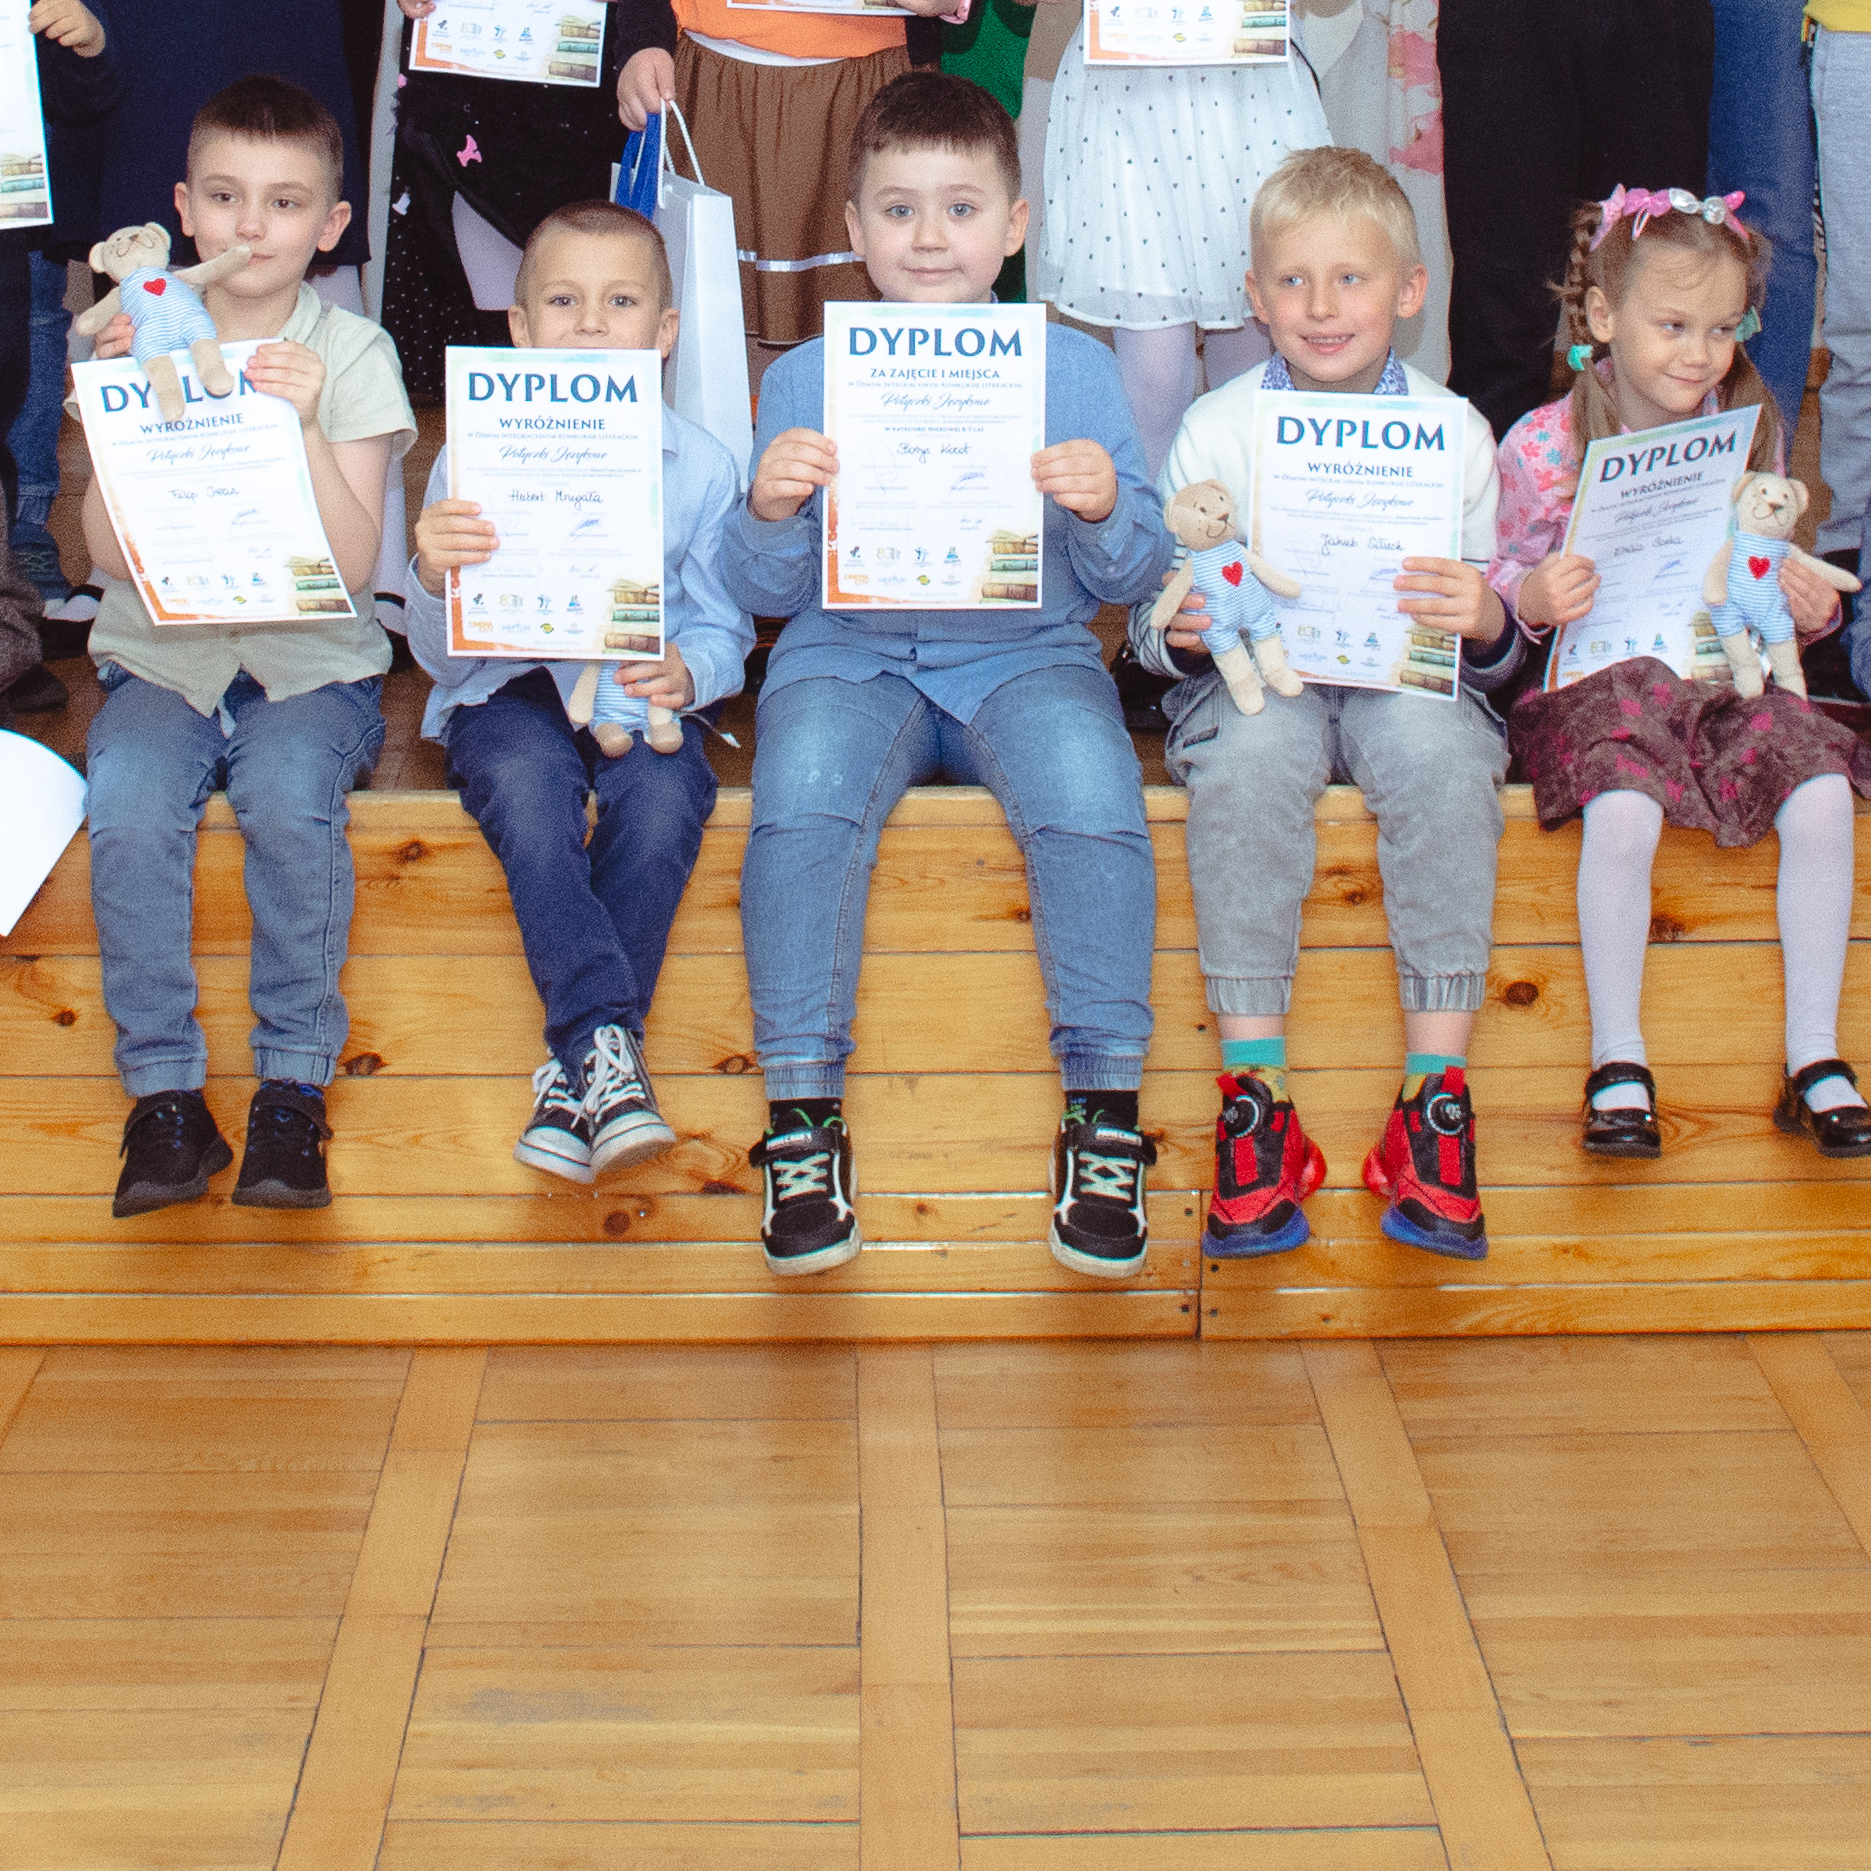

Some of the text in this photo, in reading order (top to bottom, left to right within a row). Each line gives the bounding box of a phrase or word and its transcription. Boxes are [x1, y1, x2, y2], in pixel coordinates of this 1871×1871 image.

[849, 327, 1022, 357] DYPLOM
[469, 372, 638, 403] DYPLOM
[870, 369, 1000, 382] ZA ZAJĘCIE I MIEJSCA
[499, 416, 606, 430] WYRÓŻNIENIE
[1276, 416, 1446, 451] DYPLOM
[1308, 461, 1414, 478] WYRÓŻNIENIE
[1600, 431, 1736, 483] DYPLOM
